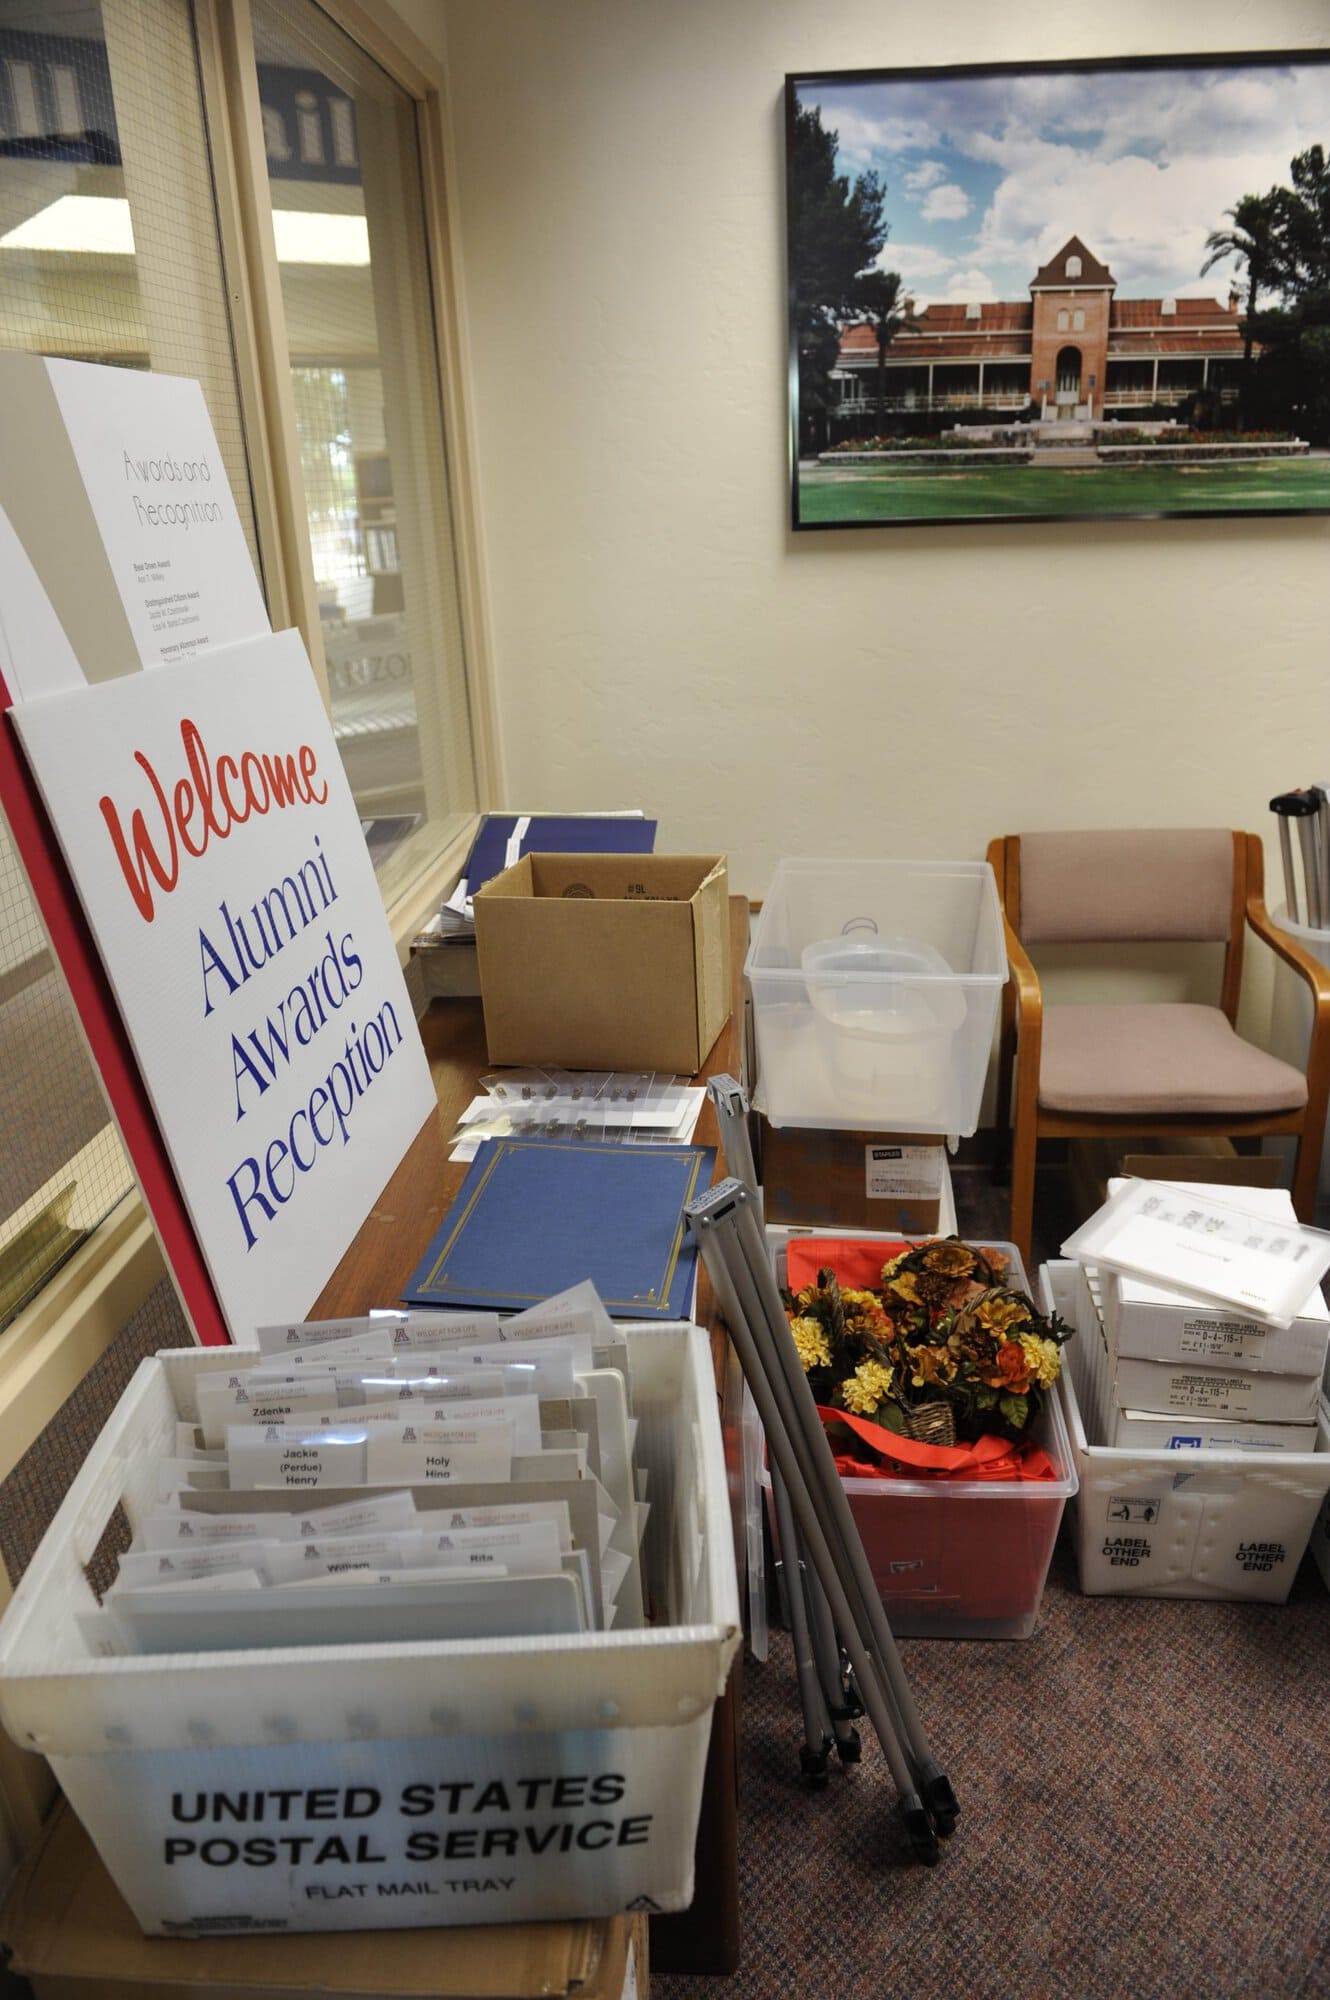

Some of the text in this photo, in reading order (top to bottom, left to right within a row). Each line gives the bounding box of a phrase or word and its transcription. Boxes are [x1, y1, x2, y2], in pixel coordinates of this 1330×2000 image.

[124, 450, 211, 482] Awards and
[133, 496, 223, 531] Recognition
[99, 718, 329, 923] Welcome
[199, 835, 340, 1017] Alumni
[230, 931, 363, 1123] Awards
[225, 1000, 402, 1253] Reception
[415, 1324, 477, 1338] WILDCAT FOR LIFE
[512, 1321, 573, 1338] WILDCAT FOR LIFE
[1202, 1331, 1243, 1344] D-4-115-1
[1189, 1386, 1229, 1398] D-4-115-1
[253, 1406, 291, 1417] Zdenka
[283, 1449, 318, 1459] Jackie
[426, 1456, 450, 1467] Holy
[280, 1463, 322, 1473] (Perdue)
[286, 1475, 318, 1486] Henry
[1105, 1537, 1152, 1549] LABEL
[1239, 1543, 1286, 1554] LABEL
[470, 1554, 493, 1563] Rita
[1102, 1547, 1151, 1558] OTHER
[1235, 1552, 1285, 1563] OTHER
[327, 1561, 370, 1573] William
[1110, 1557, 1140, 1567] END
[1242, 1562, 1273, 1572] END
[171, 1773, 627, 1824] UNITED STATES
[164, 1814, 653, 1867] POSTAL SERVICE
[305, 1876, 516, 1900] FLAT MAIL TRAY
